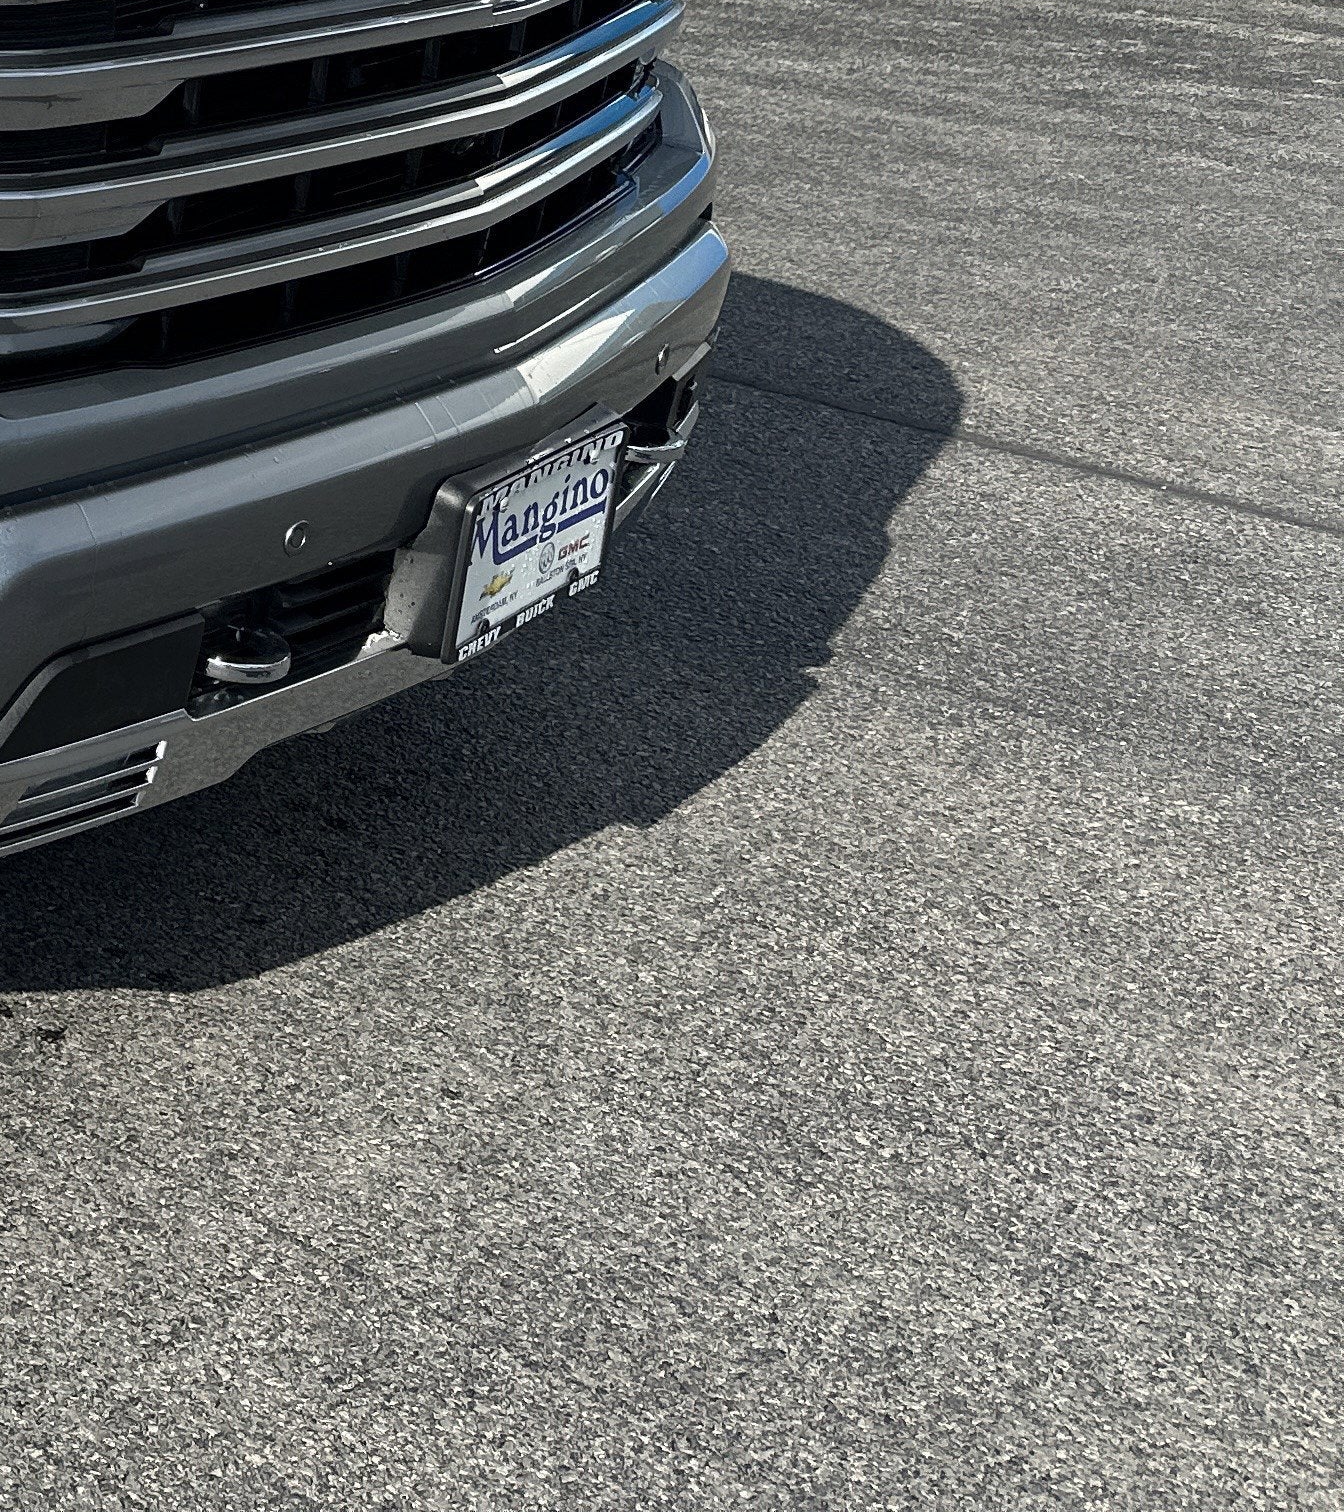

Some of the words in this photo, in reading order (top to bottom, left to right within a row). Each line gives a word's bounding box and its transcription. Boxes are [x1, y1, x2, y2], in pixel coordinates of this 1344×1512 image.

[470, 468, 609, 565] Mangino
[558, 532, 591, 561] GMC
[458, 625, 502, 662] CHEVY
[515, 594, 556, 628] BUICK
[568, 570, 600, 597] GMC
